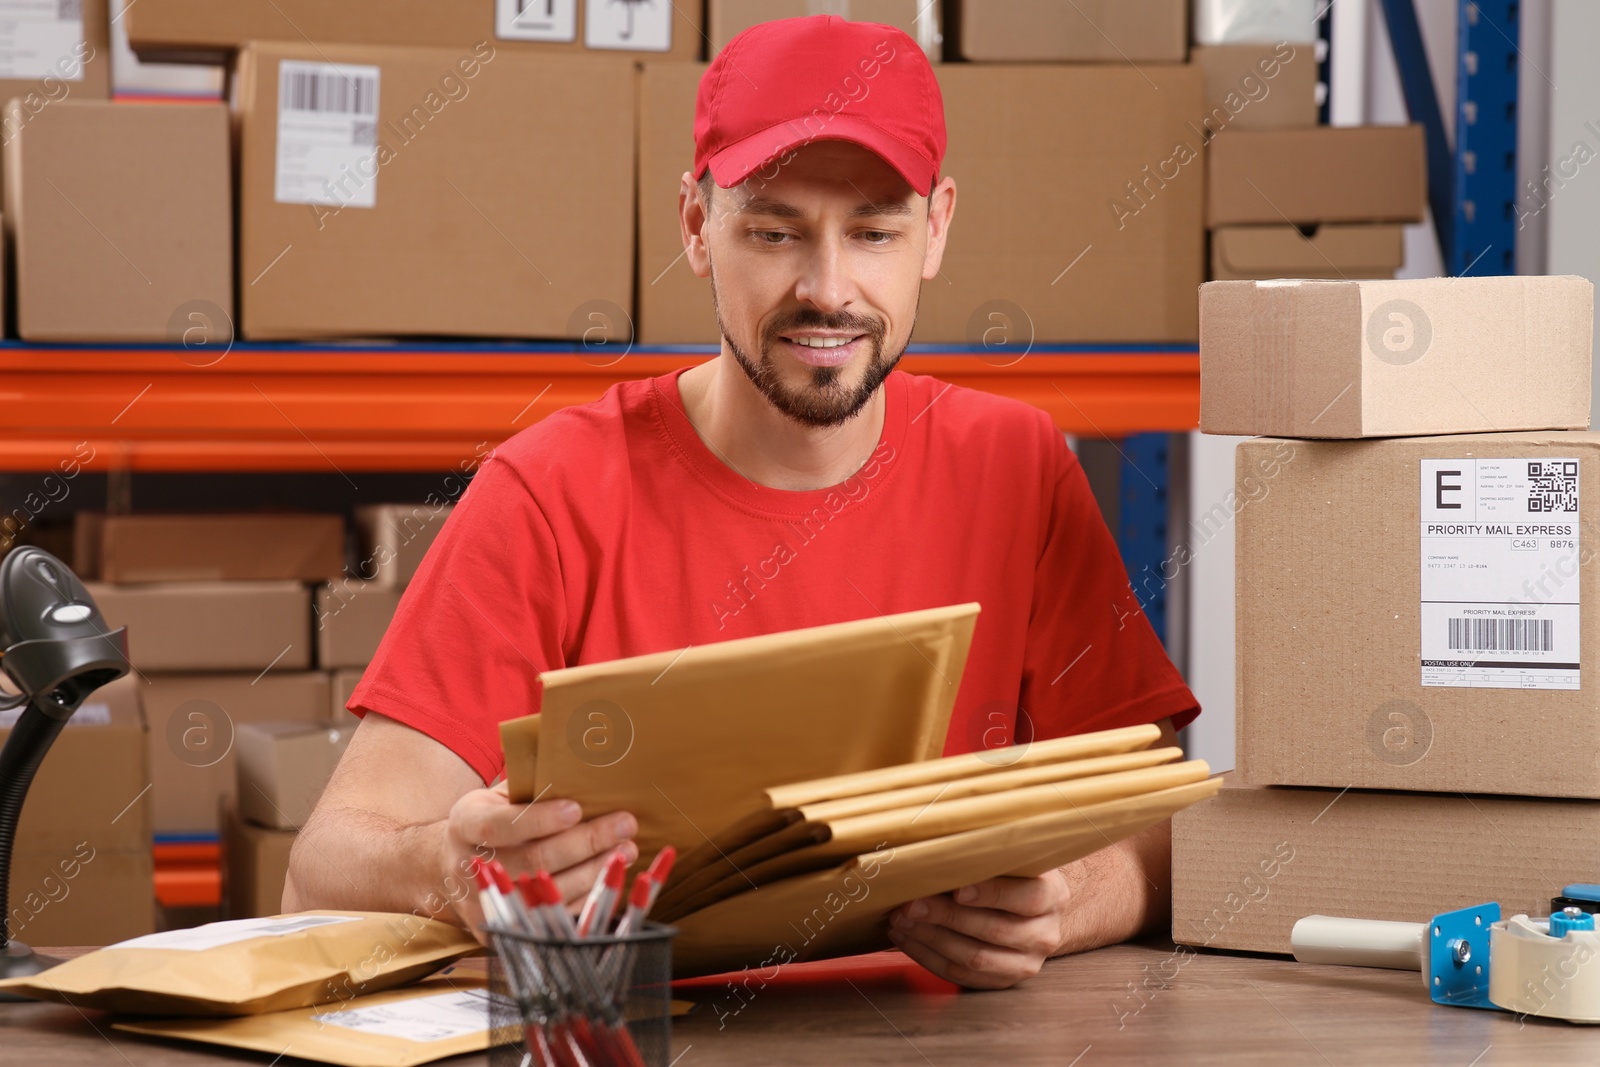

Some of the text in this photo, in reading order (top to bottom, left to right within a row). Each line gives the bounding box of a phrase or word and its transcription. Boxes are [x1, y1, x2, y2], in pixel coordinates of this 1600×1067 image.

[1436, 470, 1461, 509] E
[1428, 525, 1572, 535] PRIORITY MAIL EXPRESS
[1513, 539, 1537, 549] C463
